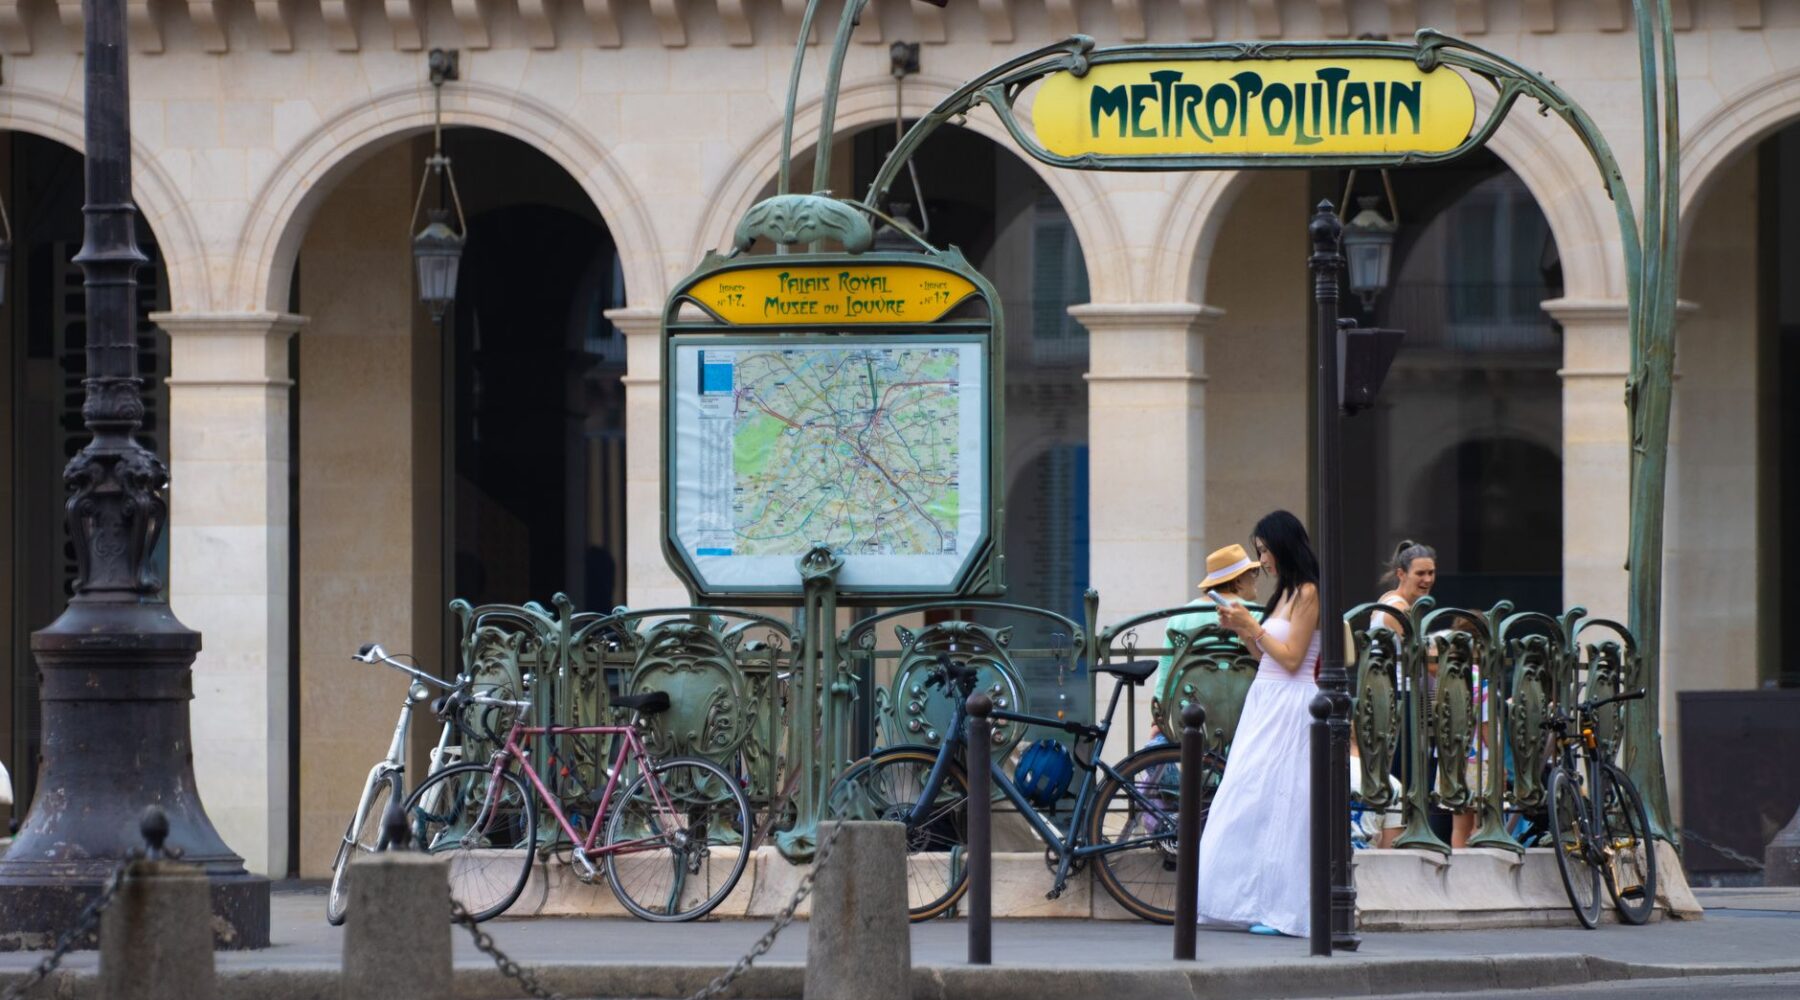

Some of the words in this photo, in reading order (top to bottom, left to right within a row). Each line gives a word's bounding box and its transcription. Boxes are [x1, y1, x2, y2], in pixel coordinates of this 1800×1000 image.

[1089, 67, 1422, 146] METROPOLITAIN
[777, 272, 830, 294] PALAIS
[838, 271, 893, 294] ROYAL
[844, 296, 905, 318] LOUVRE
